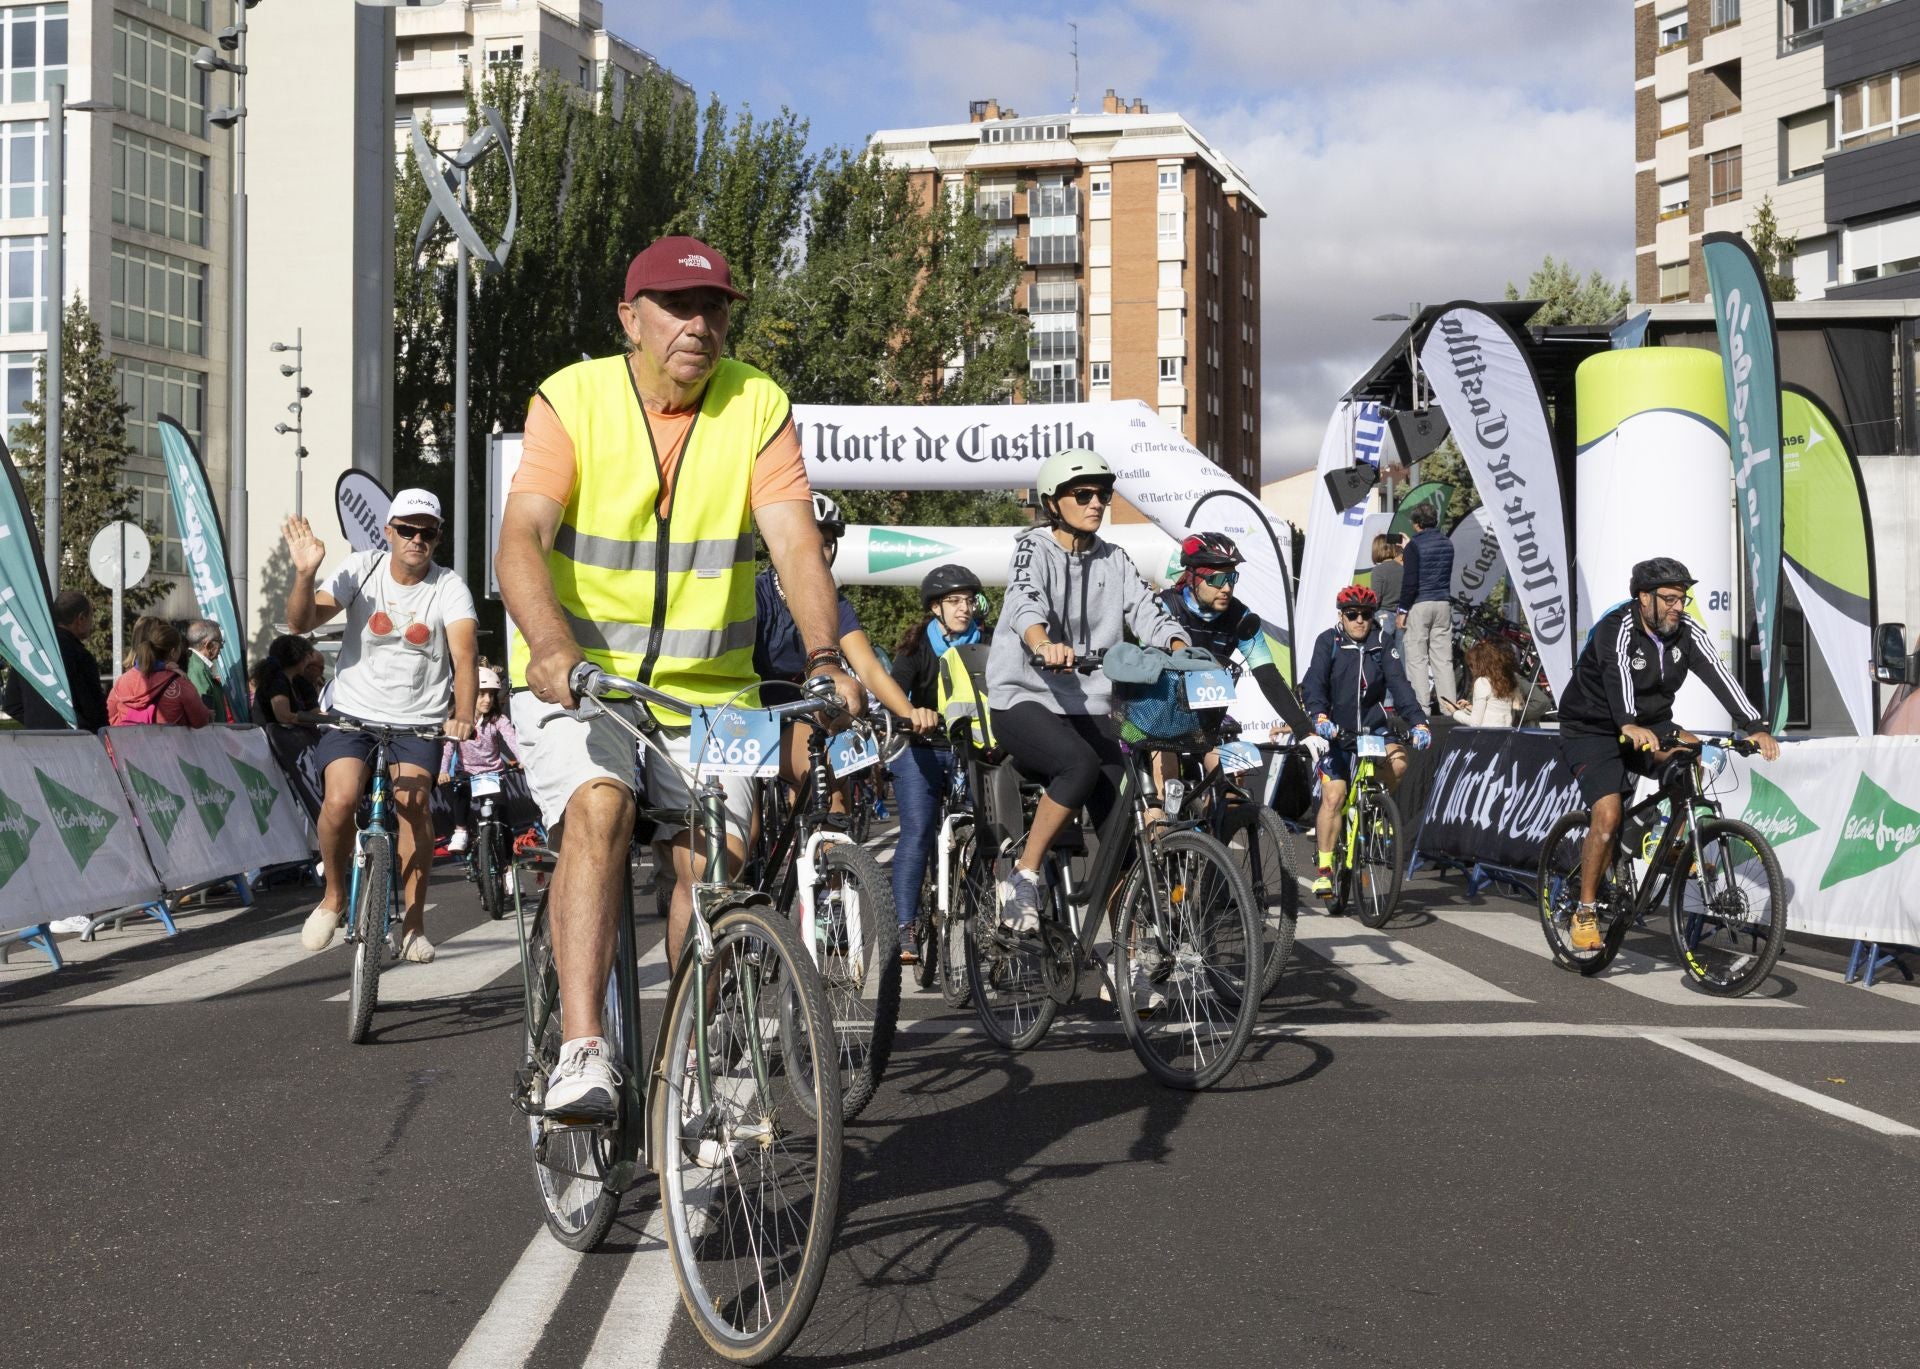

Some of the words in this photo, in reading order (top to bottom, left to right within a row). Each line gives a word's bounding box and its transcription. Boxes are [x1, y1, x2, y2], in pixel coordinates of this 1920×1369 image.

[811, 422, 906, 463] Norte
[913, 426, 950, 463] de
[956, 421, 1095, 463] Castilla
[1145, 442, 1168, 452] Norte
[1169, 444, 1177, 452] de
[1117, 468, 1150, 479] Castilla
[1150, 492, 1173, 502] Norte
[1174, 492, 1183, 501] de
[1196, 685, 1228, 702] 902
[1239, 721, 1258, 731] orte
[1260, 720, 1270, 730] de
[707, 738, 761, 765] 868
